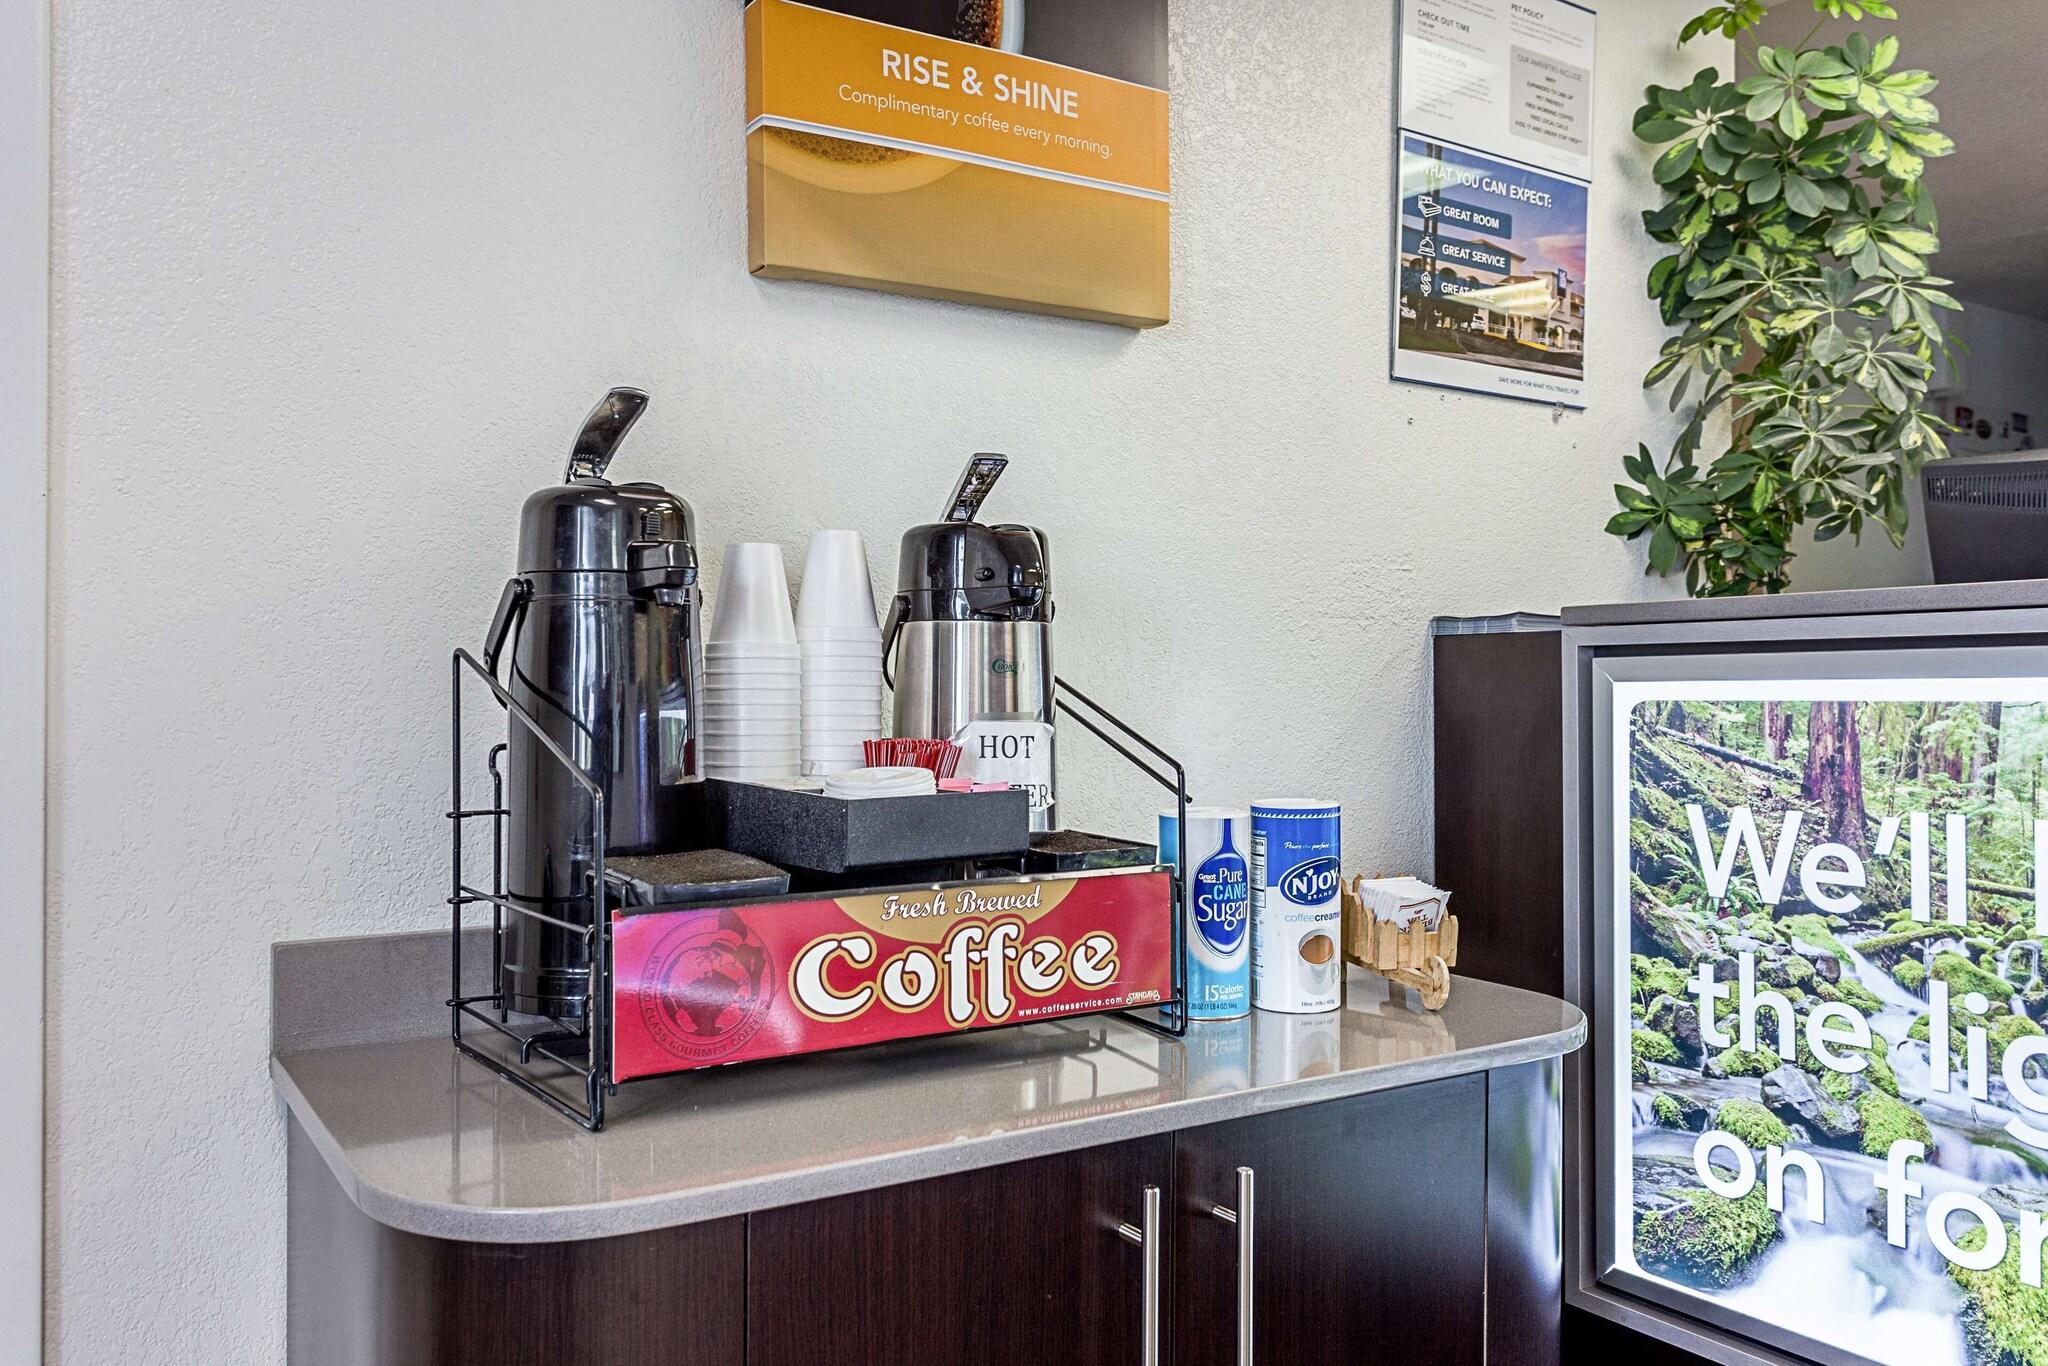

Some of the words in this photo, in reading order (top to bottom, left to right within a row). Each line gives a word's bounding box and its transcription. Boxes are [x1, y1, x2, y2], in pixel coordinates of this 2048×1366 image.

[1417, 9, 1439, 22] CHECK
[1441, 17, 1454, 27] OUT
[1456, 22, 1470, 33] TIME
[1511, 3, 1522, 13] PET
[1523, 7, 1544, 20] POLICY
[882, 48, 950, 90] RISE
[961, 66, 983, 96] &
[994, 74, 1079, 118] SHINE
[838, 84, 959, 126] Complimentary
[964, 110, 1009, 133] coffee
[1013, 123, 1050, 146] every
[1055, 132, 1113, 159] morning.
[1456, 169, 1480, 189] YOU
[1482, 177, 1506, 196] CAN
[1510, 185, 1552, 208] EXPECT:
[1443, 205, 1471, 221] GREAT
[1473, 213, 1499, 229] ROOM
[1442, 244, 1470, 260] GREAT
[1472, 250, 1505, 267] SERVICE
[1441, 282, 1469, 296] GREAT
[978, 734, 1035, 759] HOT
[1219, 867, 1243, 883] Pure
[1685, 802, 1967, 927] We'll
[881, 891, 948, 921] Fresh
[954, 884, 1042, 914] Brewed
[1213, 882, 1247, 901] CANE
[1307, 890, 1332, 900] BRAND
[1197, 894, 1248, 931] Sugar
[790, 922, 1119, 1026] Coffee
[1205, 984, 1219, 1001] 15
[1018, 996, 1123, 1017] www.coffeeservice.com
[1688, 952, 1872, 1073] the
[645, 1006, 667, 1042] CLASS
[669, 1039, 728, 1057] GOURMET
[1692, 1130, 1826, 1225] on
